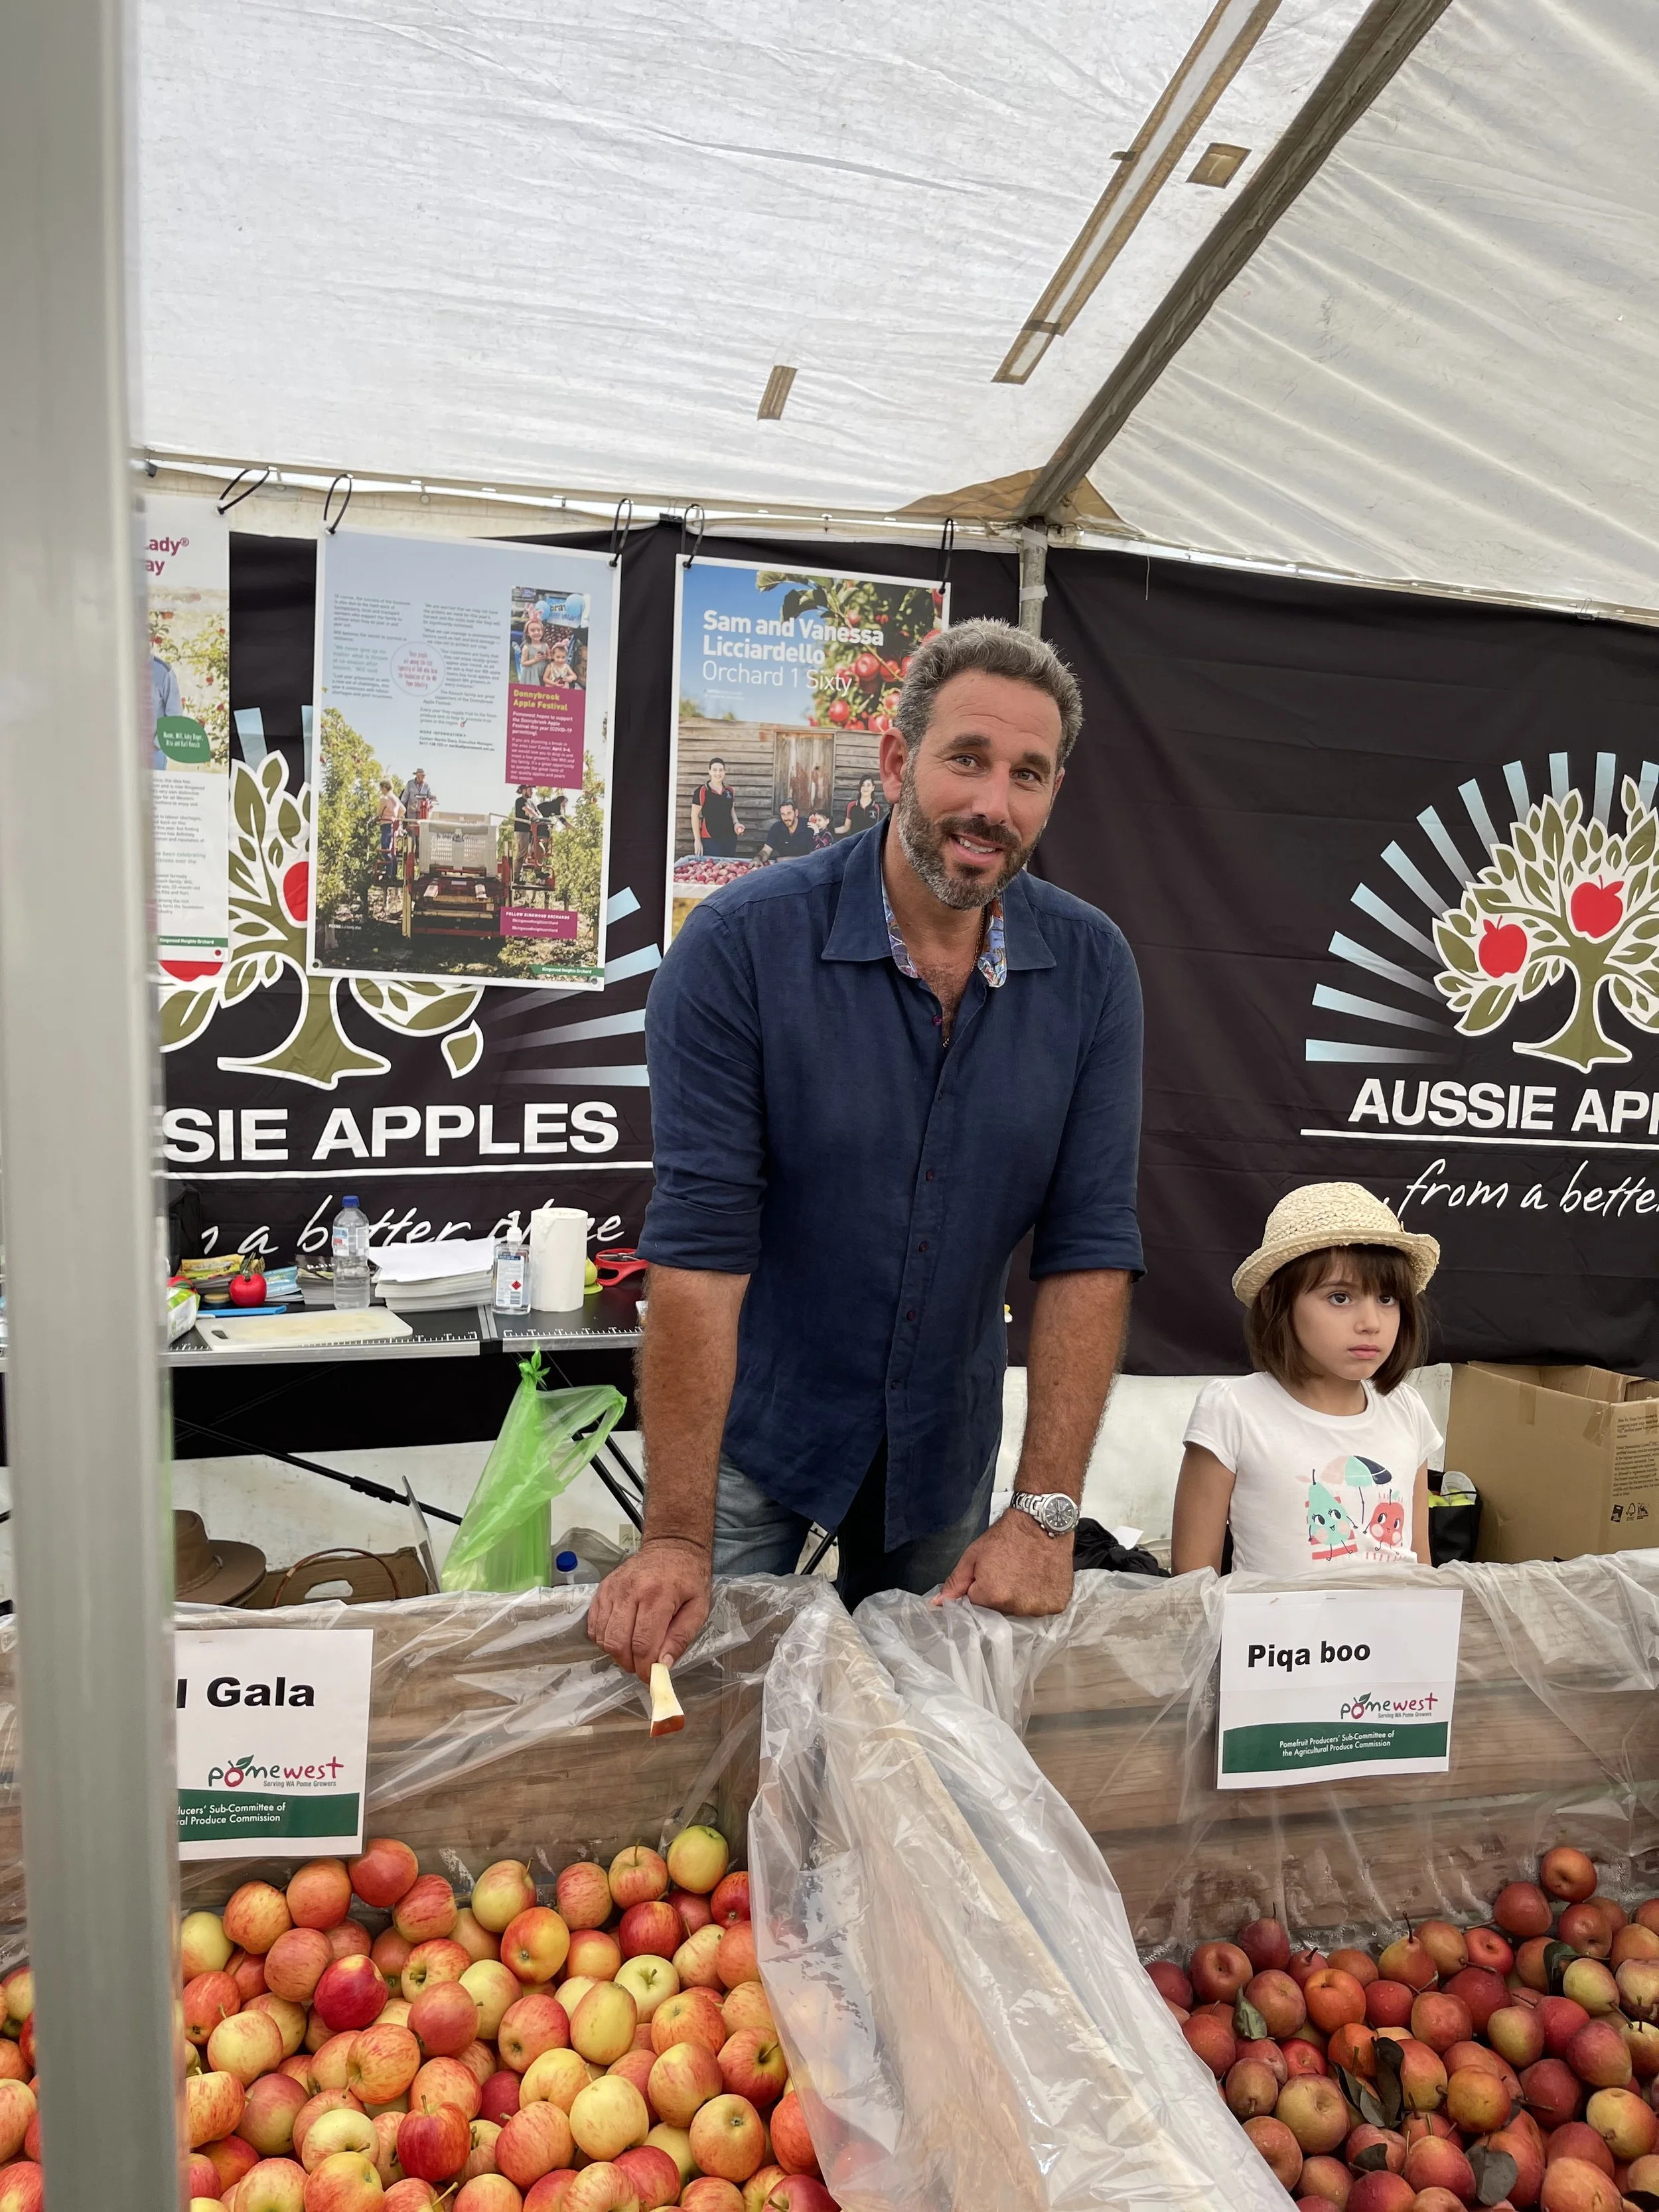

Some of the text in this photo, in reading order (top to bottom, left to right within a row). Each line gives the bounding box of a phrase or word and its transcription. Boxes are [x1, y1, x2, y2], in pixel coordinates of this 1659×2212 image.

[144, 536, 190, 556] ady®
[703, 609, 884, 647] Sam and Vanessa
[703, 634, 826, 665] Licciardello
[702, 660, 853, 697] Orchard 1 Sixty
[513, 699, 568, 711] Apple Festival
[514, 690, 560, 701] Donnybrook
[1348, 1078, 1556, 1130] AUSSIE
[311, 1101, 620, 1160] APPLES
[1520, 1183, 1548, 1210] a
[1559, 1160, 1659, 1217] bette
[238, 1224, 279, 1256] a
[1248, 1641, 1370, 1672] Piqa boo
[206, 1676, 315, 1708] Gala
[1340, 1692, 1438, 1720] pomewest
[1279, 1739, 1308, 1748] Pomefruit
[1309, 1734, 1340, 1745] Producers'
[1342, 1732, 1386, 1742] Sub-Committee
[1293, 1745, 1329, 1757] Agricultural
[1329, 1743, 1353, 1751] Produce
[1355, 1739, 1391, 1749] Commission
[208, 1754, 344, 1787] pomewest
[190, 1815, 227, 1825] Produce
[229, 1813, 281, 1823] Commission
[209, 1803, 274, 1814] Sub-Committee
[276, 1802, 287, 1811] of
